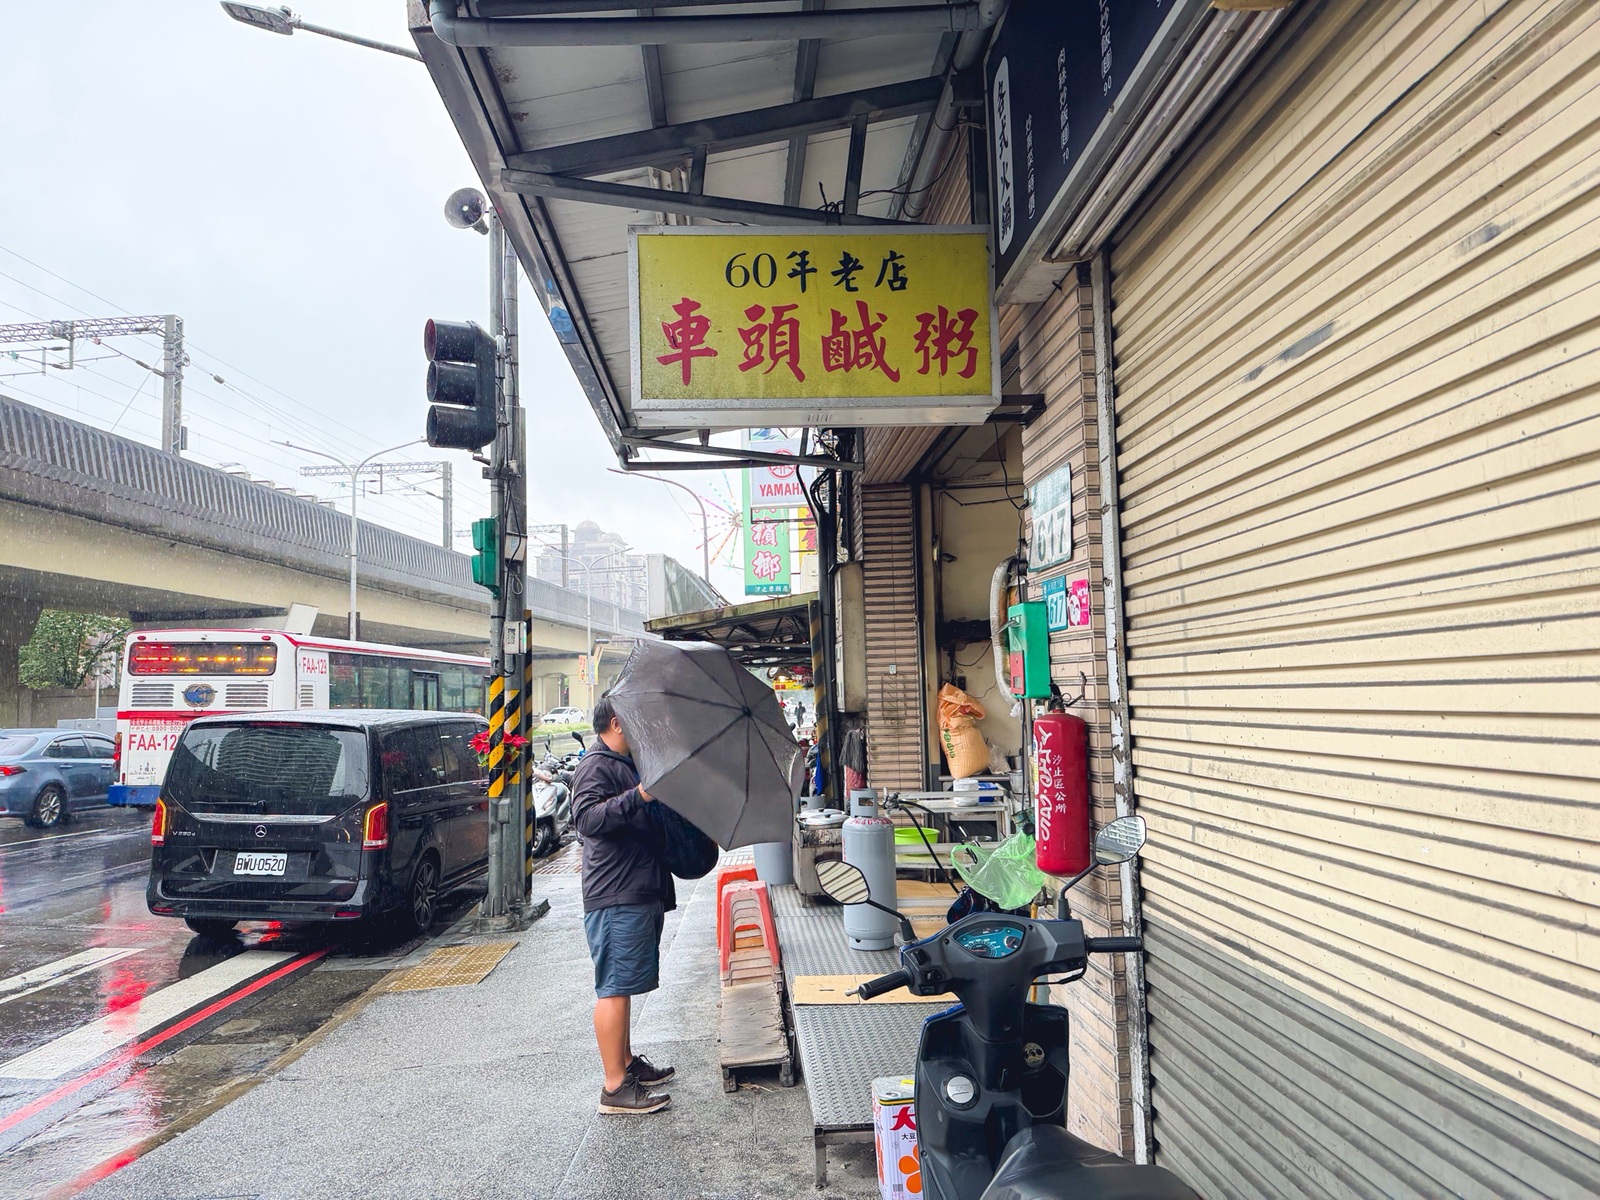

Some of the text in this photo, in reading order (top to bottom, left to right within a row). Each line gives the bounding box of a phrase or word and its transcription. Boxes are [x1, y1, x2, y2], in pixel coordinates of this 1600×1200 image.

[1103, 75, 1113, 96] 90
[997, 80, 1012, 241] 各式火鍋
[725, 249, 909, 293] 60年老店
[655, 297, 979, 386] 車頭鹹粥
[1037, 507, 1066, 562] 617
[1049, 594, 1064, 625] 617
[302, 657, 327, 675] FAA-129
[128, 733, 180, 751] FAA-12
[1052, 754, 1067, 814] 汐止區公所
[901, 1132, 918, 1141] 大豆
